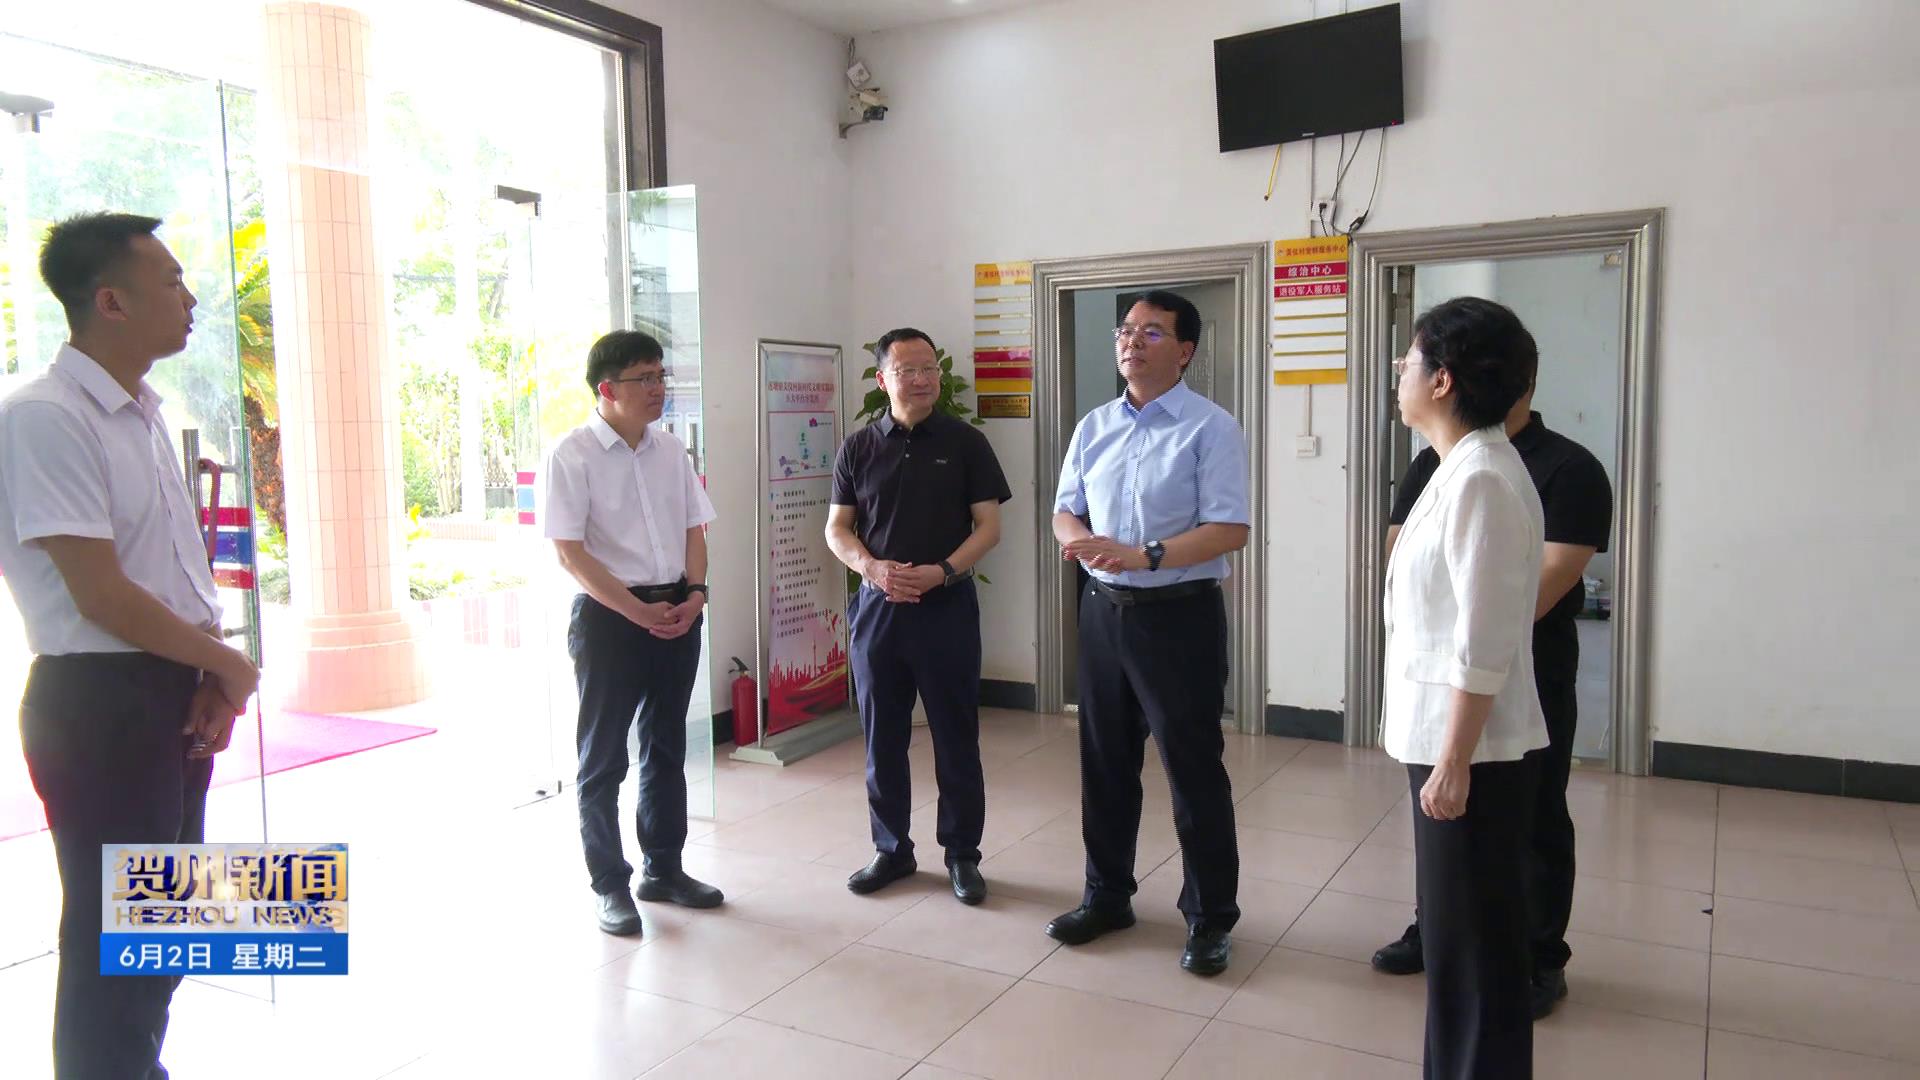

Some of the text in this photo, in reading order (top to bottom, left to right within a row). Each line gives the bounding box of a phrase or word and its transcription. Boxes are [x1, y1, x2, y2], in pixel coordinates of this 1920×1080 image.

[1288, 265, 1332, 277] 综治中心
[1280, 284, 1341, 296] 退役军人服务站
